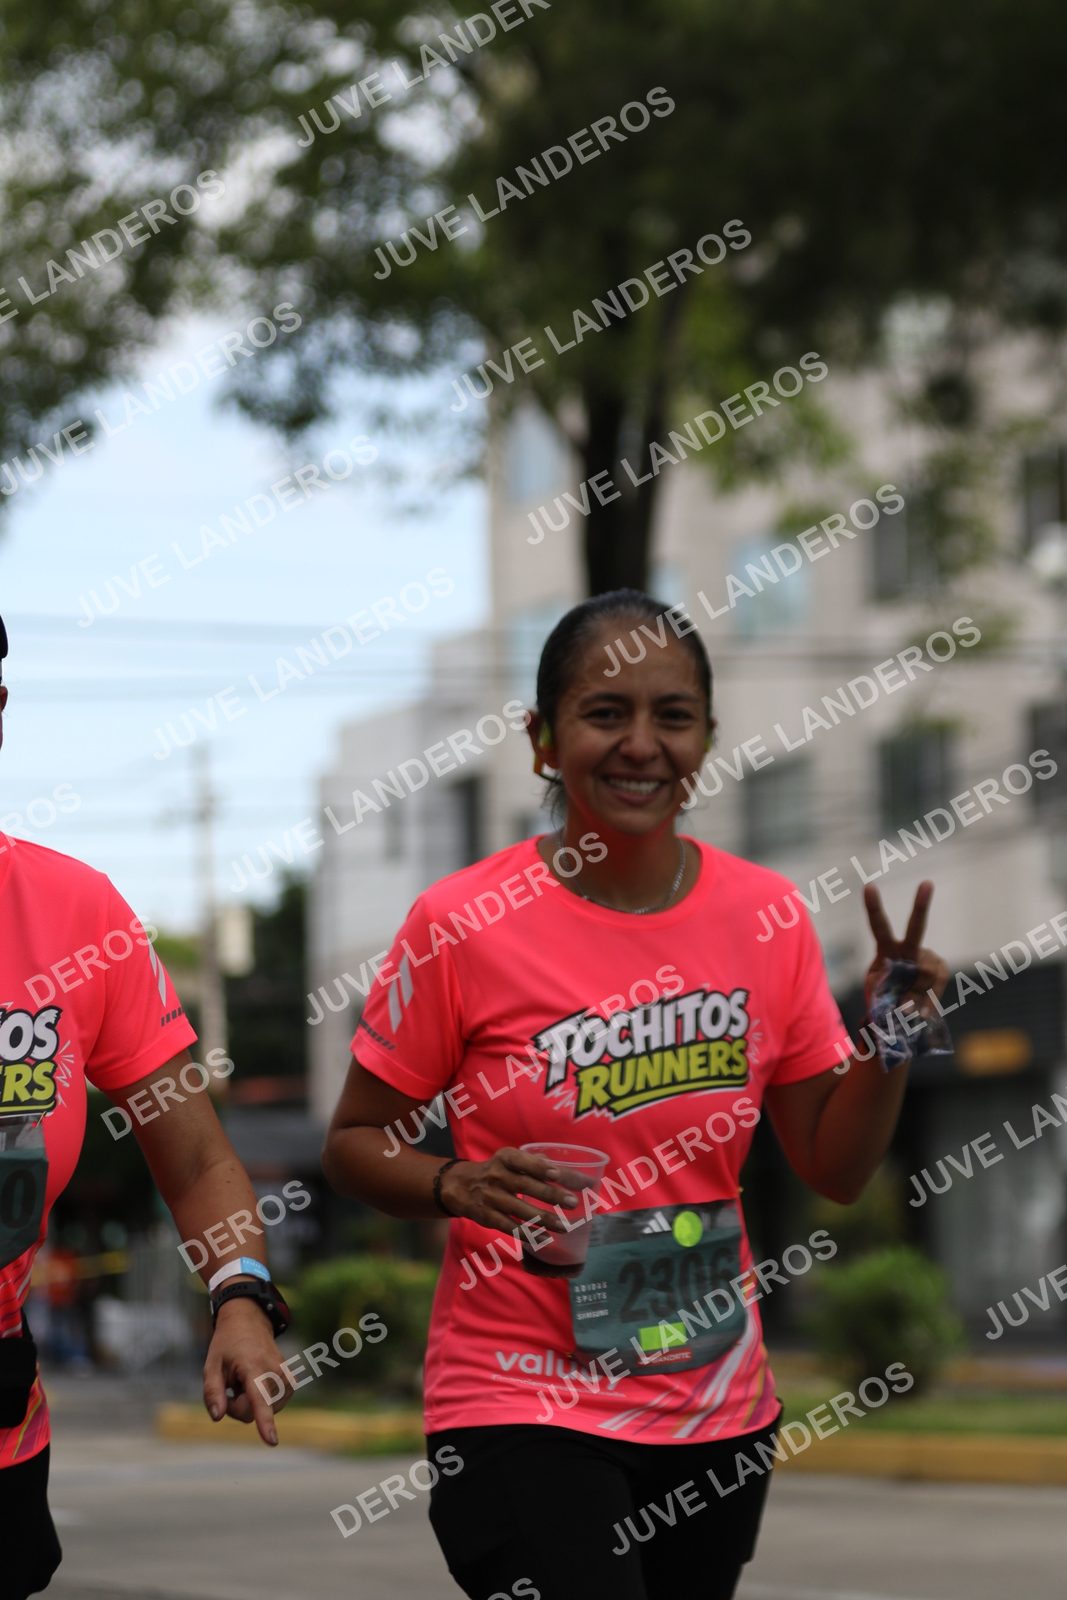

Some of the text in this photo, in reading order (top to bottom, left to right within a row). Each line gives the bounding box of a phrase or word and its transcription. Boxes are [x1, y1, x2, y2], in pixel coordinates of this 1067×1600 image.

[0, 1008, 61, 1062] OS
[535, 987, 750, 1092] TOCHITOS
[0, 1062, 57, 1103] RS
[577, 1040, 748, 1112] RUNNERS
